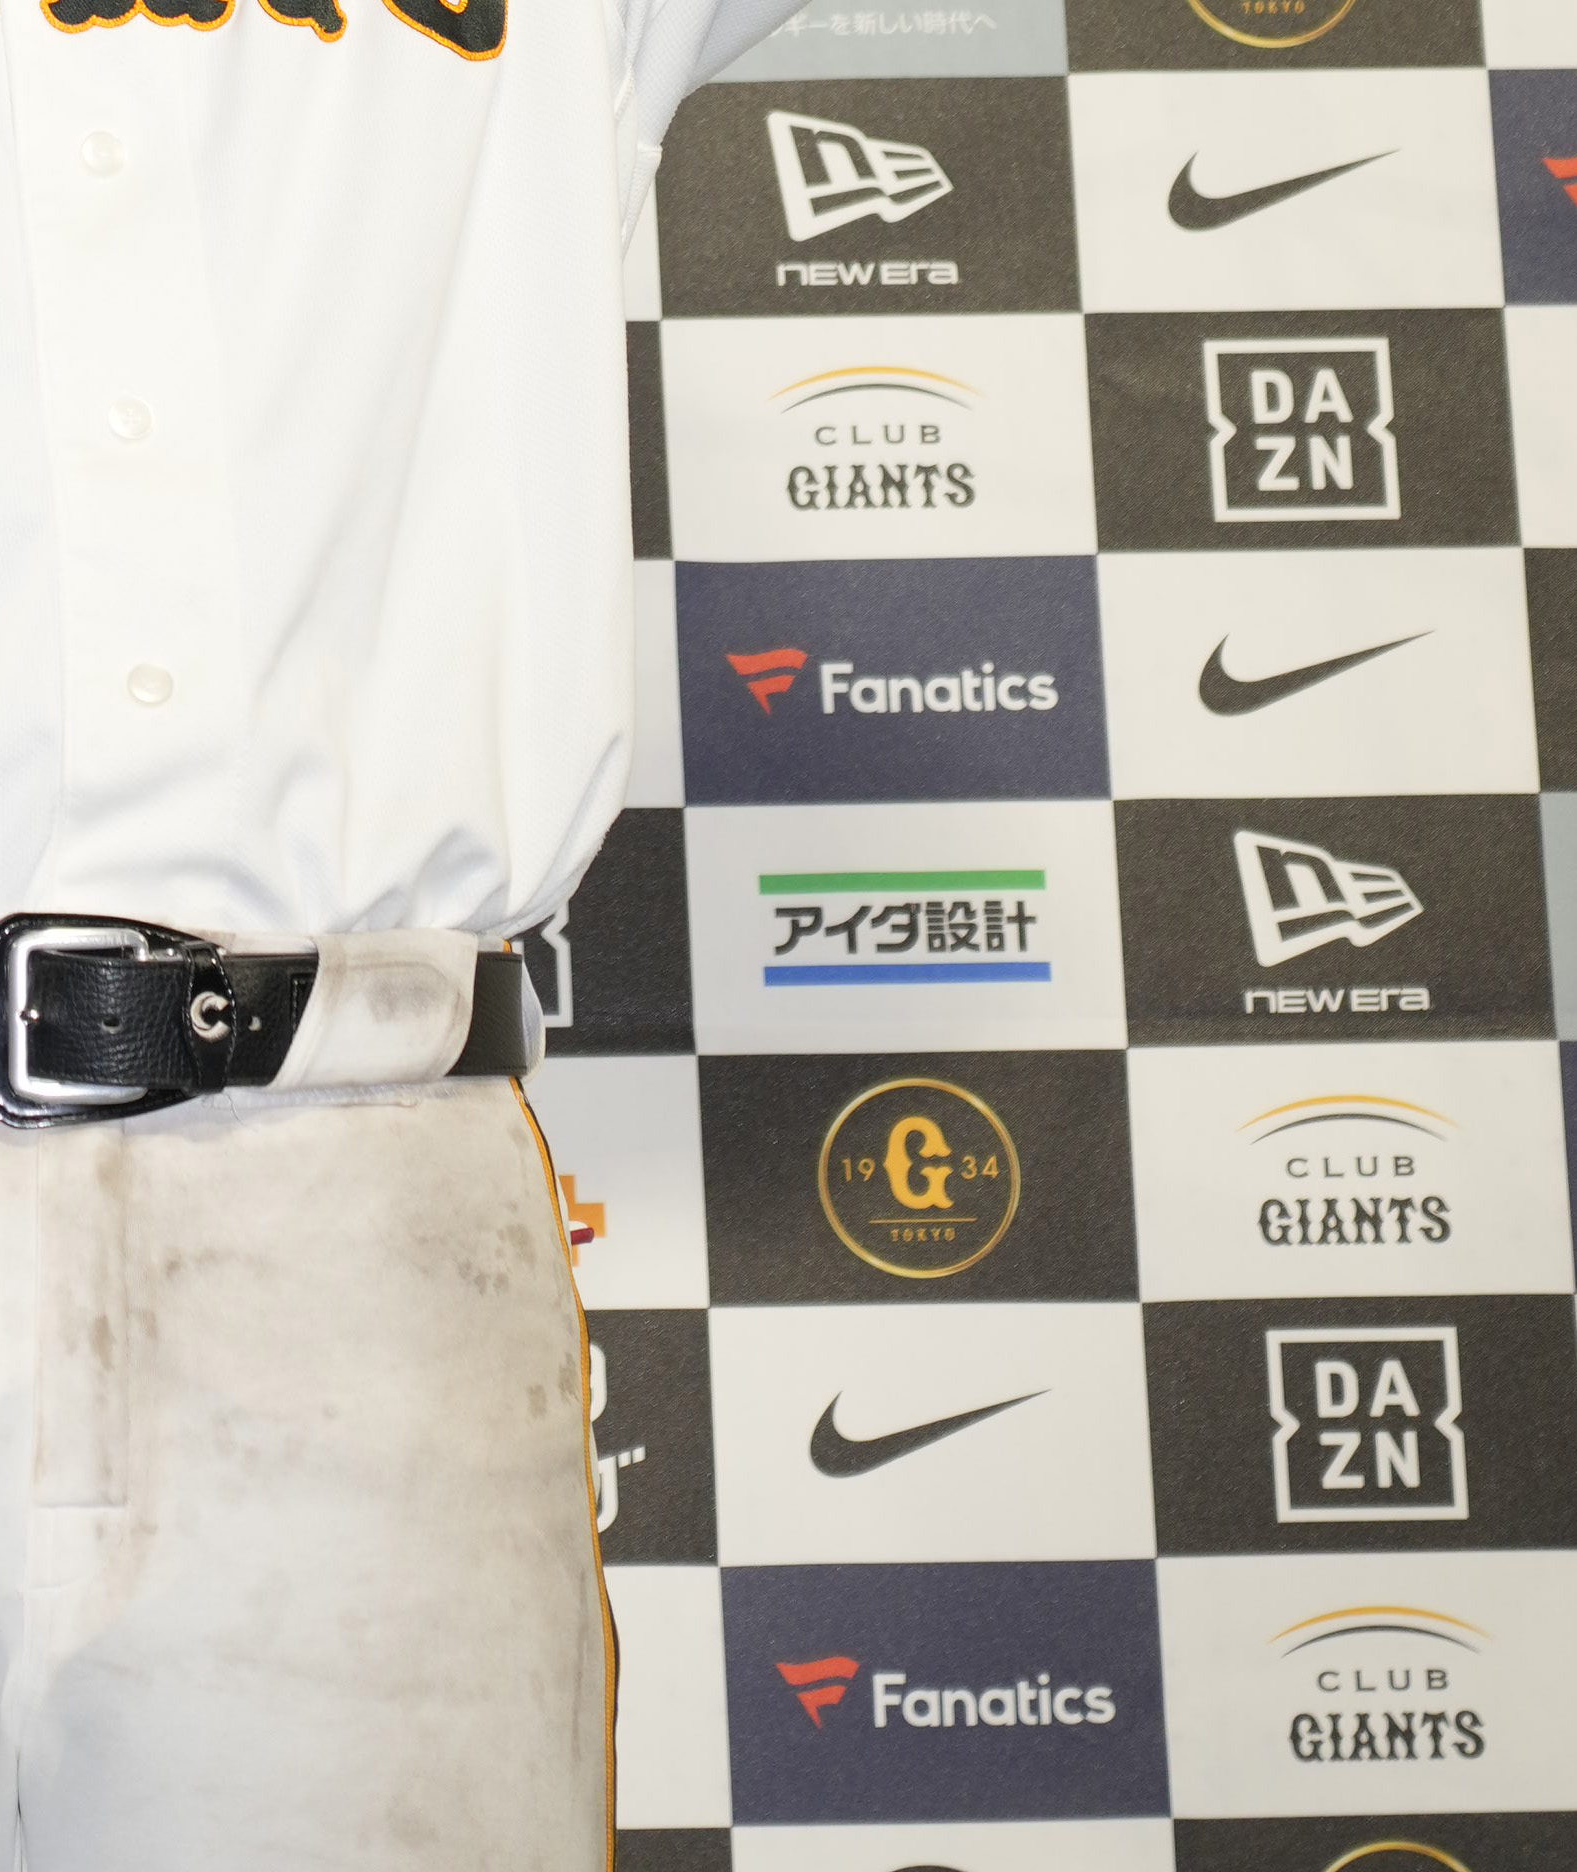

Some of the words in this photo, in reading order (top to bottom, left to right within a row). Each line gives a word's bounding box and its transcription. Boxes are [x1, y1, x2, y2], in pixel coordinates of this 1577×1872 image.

[1250, 368, 1352, 423] DA
[814, 424, 940, 446] CLUB
[787, 463, 974, 510] GIANTS
[1255, 435, 1353, 491] ZN
[821, 662, 1058, 713] Fanatics
[775, 901, 1035, 955] アイダ設計
[843, 1158, 875, 1181] 19
[884, 1116, 953, 1209] G
[962, 1155, 998, 1179] 34
[1286, 1155, 1415, 1178] CLUB
[1258, 1196, 1450, 1245] GIANTS
[1315, 1360, 1419, 1418] DA
[1320, 1430, 1419, 1489] ZN
[873, 1673, 1115, 1727] Fanatics
[1317, 1669, 1448, 1692] CLUB
[1289, 1710, 1484, 1762] GIANTS
